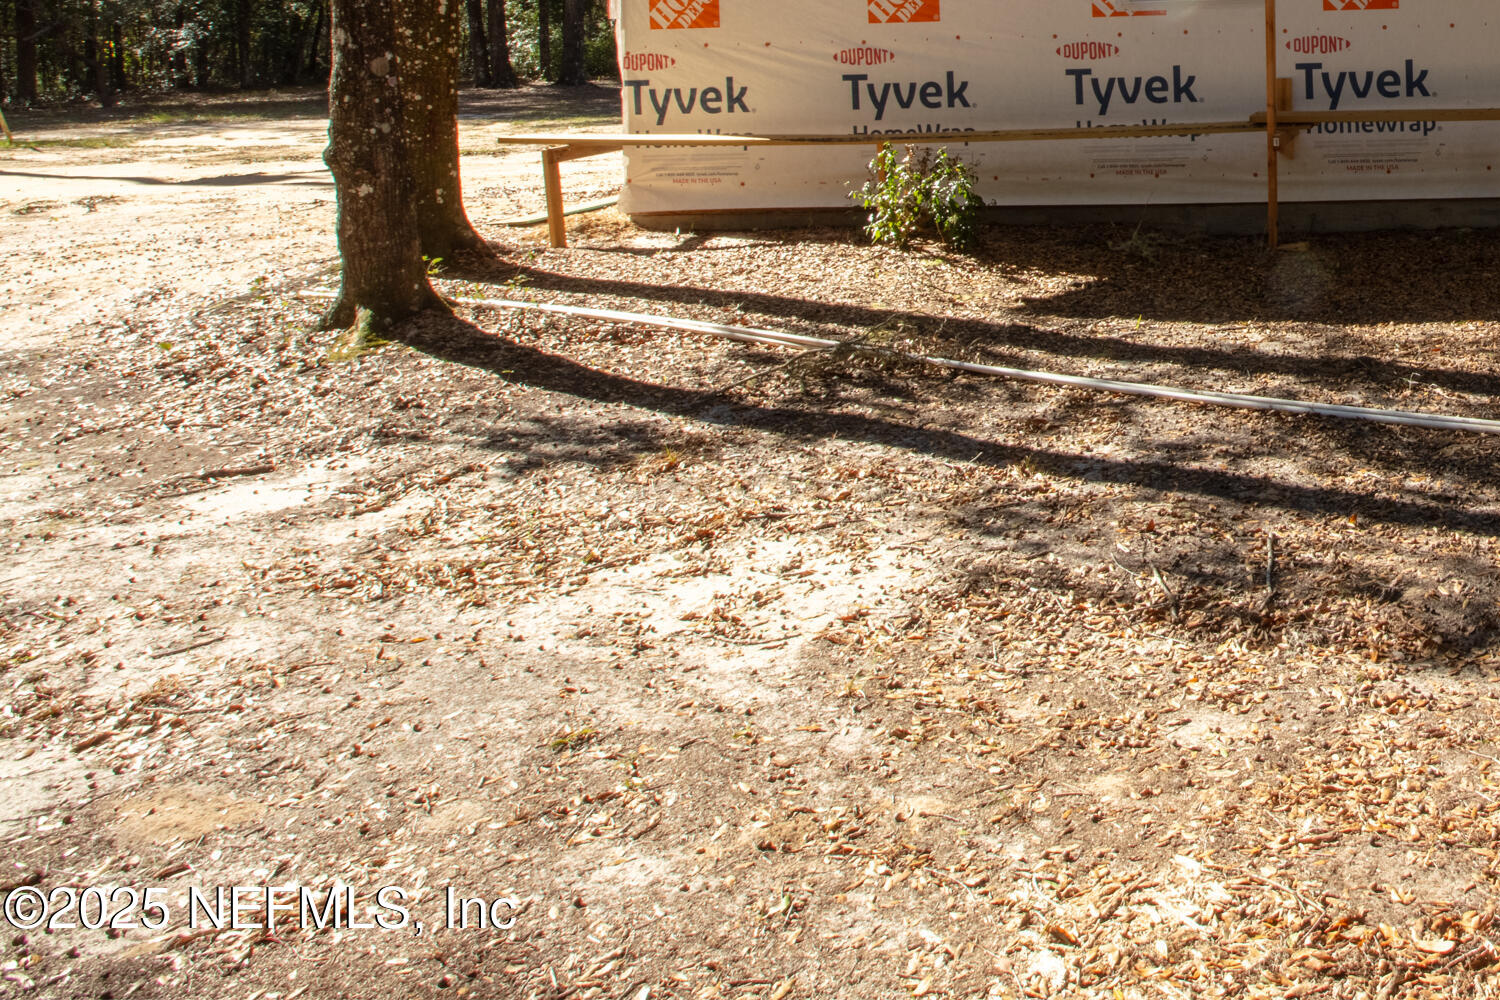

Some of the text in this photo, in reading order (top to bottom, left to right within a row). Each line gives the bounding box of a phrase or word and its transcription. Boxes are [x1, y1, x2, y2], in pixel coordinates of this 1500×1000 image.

[840, 47, 888, 65] DUPONT
[1064, 42, 1113, 60] DUPONT
[1294, 35, 1344, 54] DUPONT
[623, 53, 671, 71] DUPONT
[624, 76, 750, 126] Tyvek
[842, 71, 971, 121] Tyvek
[1065, 65, 1198, 115] Tyvek
[1295, 59, 1431, 110] Tyvek
